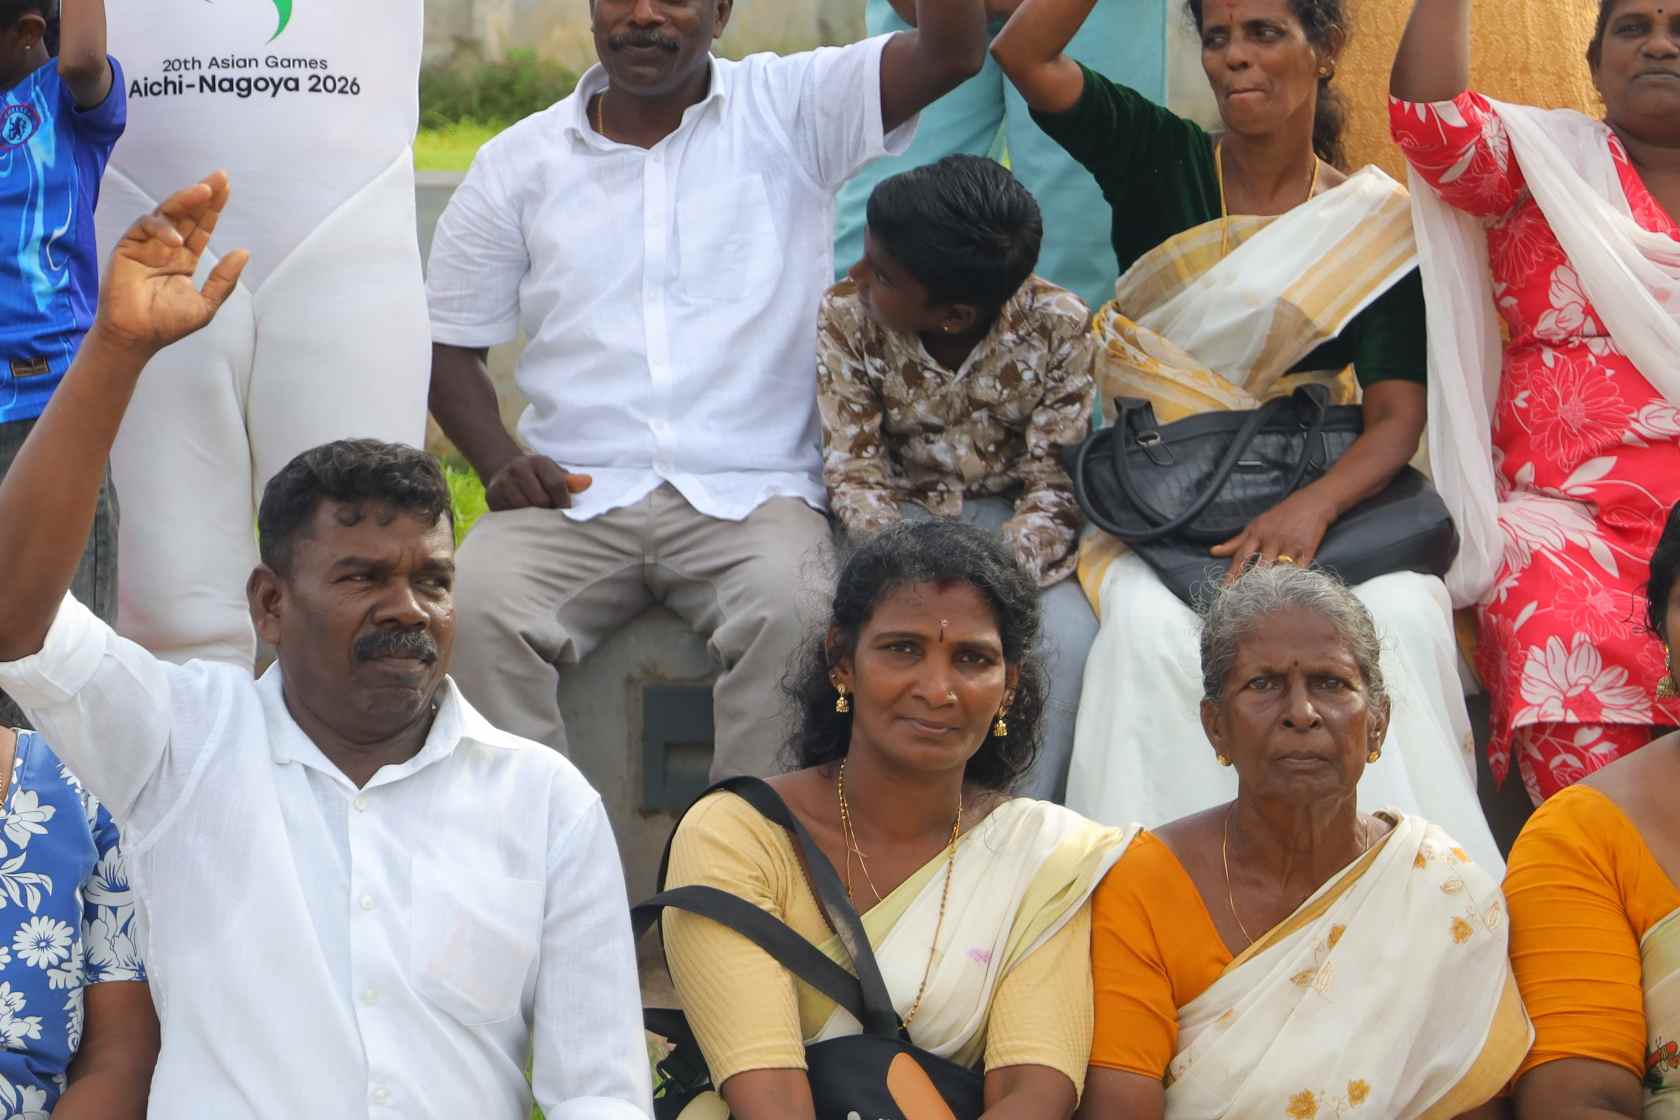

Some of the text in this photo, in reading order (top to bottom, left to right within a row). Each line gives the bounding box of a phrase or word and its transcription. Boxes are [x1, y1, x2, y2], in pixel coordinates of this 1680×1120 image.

[162, 53, 328, 72] 20th Asian Games
[128, 73, 361, 99] Aichi-Nagoya 2026
